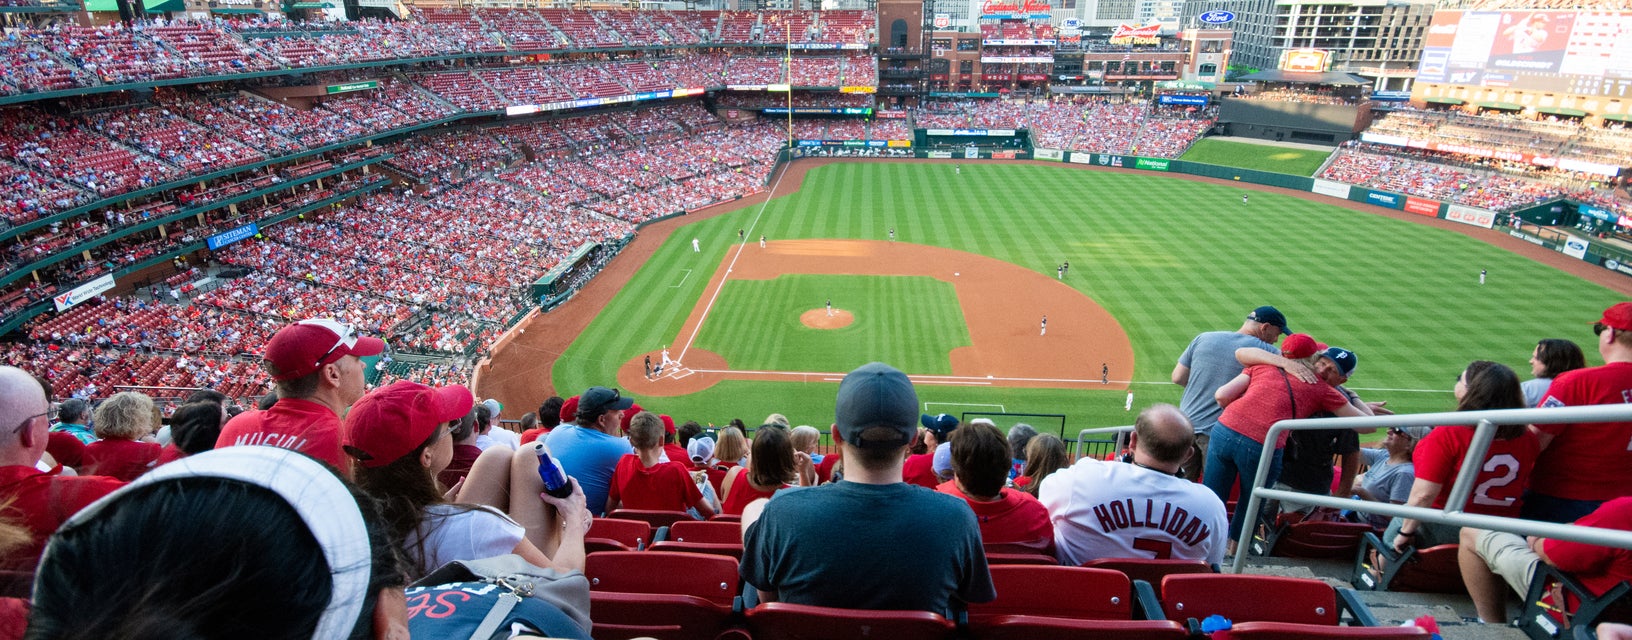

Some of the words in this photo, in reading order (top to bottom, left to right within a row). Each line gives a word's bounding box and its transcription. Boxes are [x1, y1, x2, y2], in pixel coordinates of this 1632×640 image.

[983, 0, 1018, 14] Cardinals
[1118, 28, 1157, 36] Budweiser
[1604, 84, 1611, 95] 1
[223, 225, 251, 239] SITEMAN
[93, 280, 113, 291] Technology
[1474, 454, 1520, 506] 2
[1093, 499, 1210, 547] HOLLIDAY
